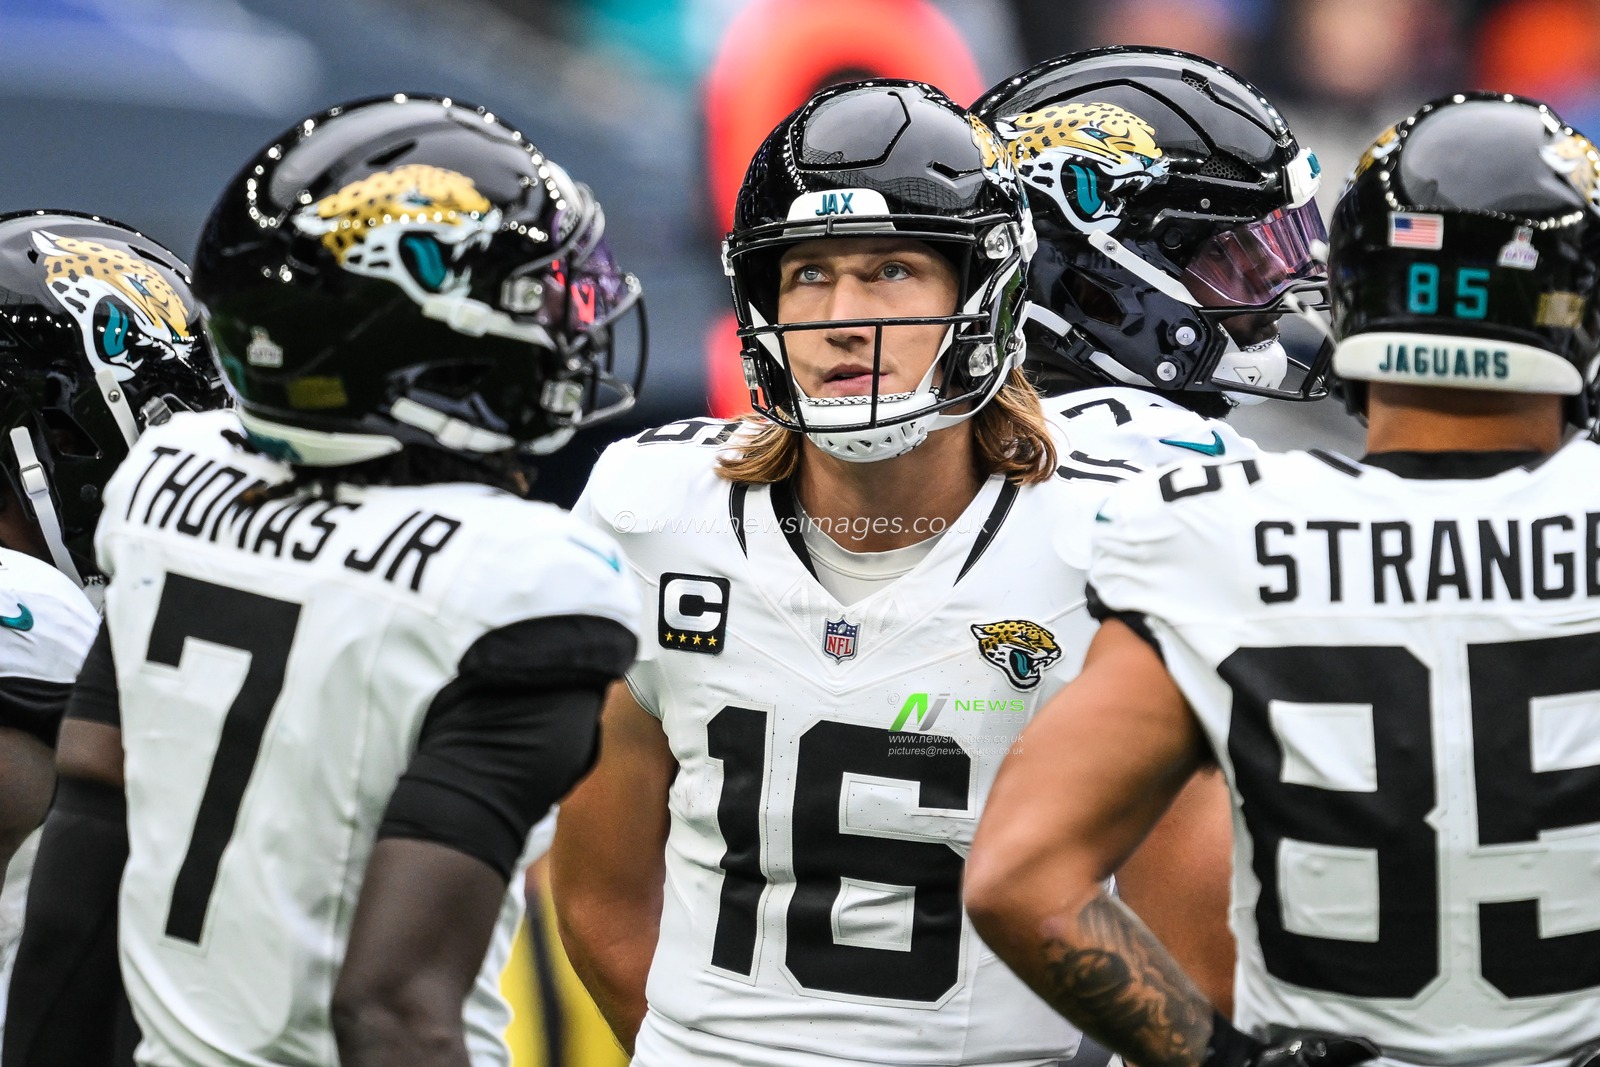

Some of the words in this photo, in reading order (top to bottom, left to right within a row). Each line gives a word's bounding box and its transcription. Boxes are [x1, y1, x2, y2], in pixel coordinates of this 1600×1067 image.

[815, 192, 854, 216] JAX
[1407, 262, 1491, 320] 85
[1379, 344, 1511, 379] JAGUARS
[125, 445, 363, 562] THOMAS
[343, 510, 462, 593] JR
[663, 578, 724, 633] C
[826, 634, 853, 656] NFL
[145, 571, 302, 945] 7
[1216, 634, 1600, 1001] 85
[706, 705, 972, 1003] 16
